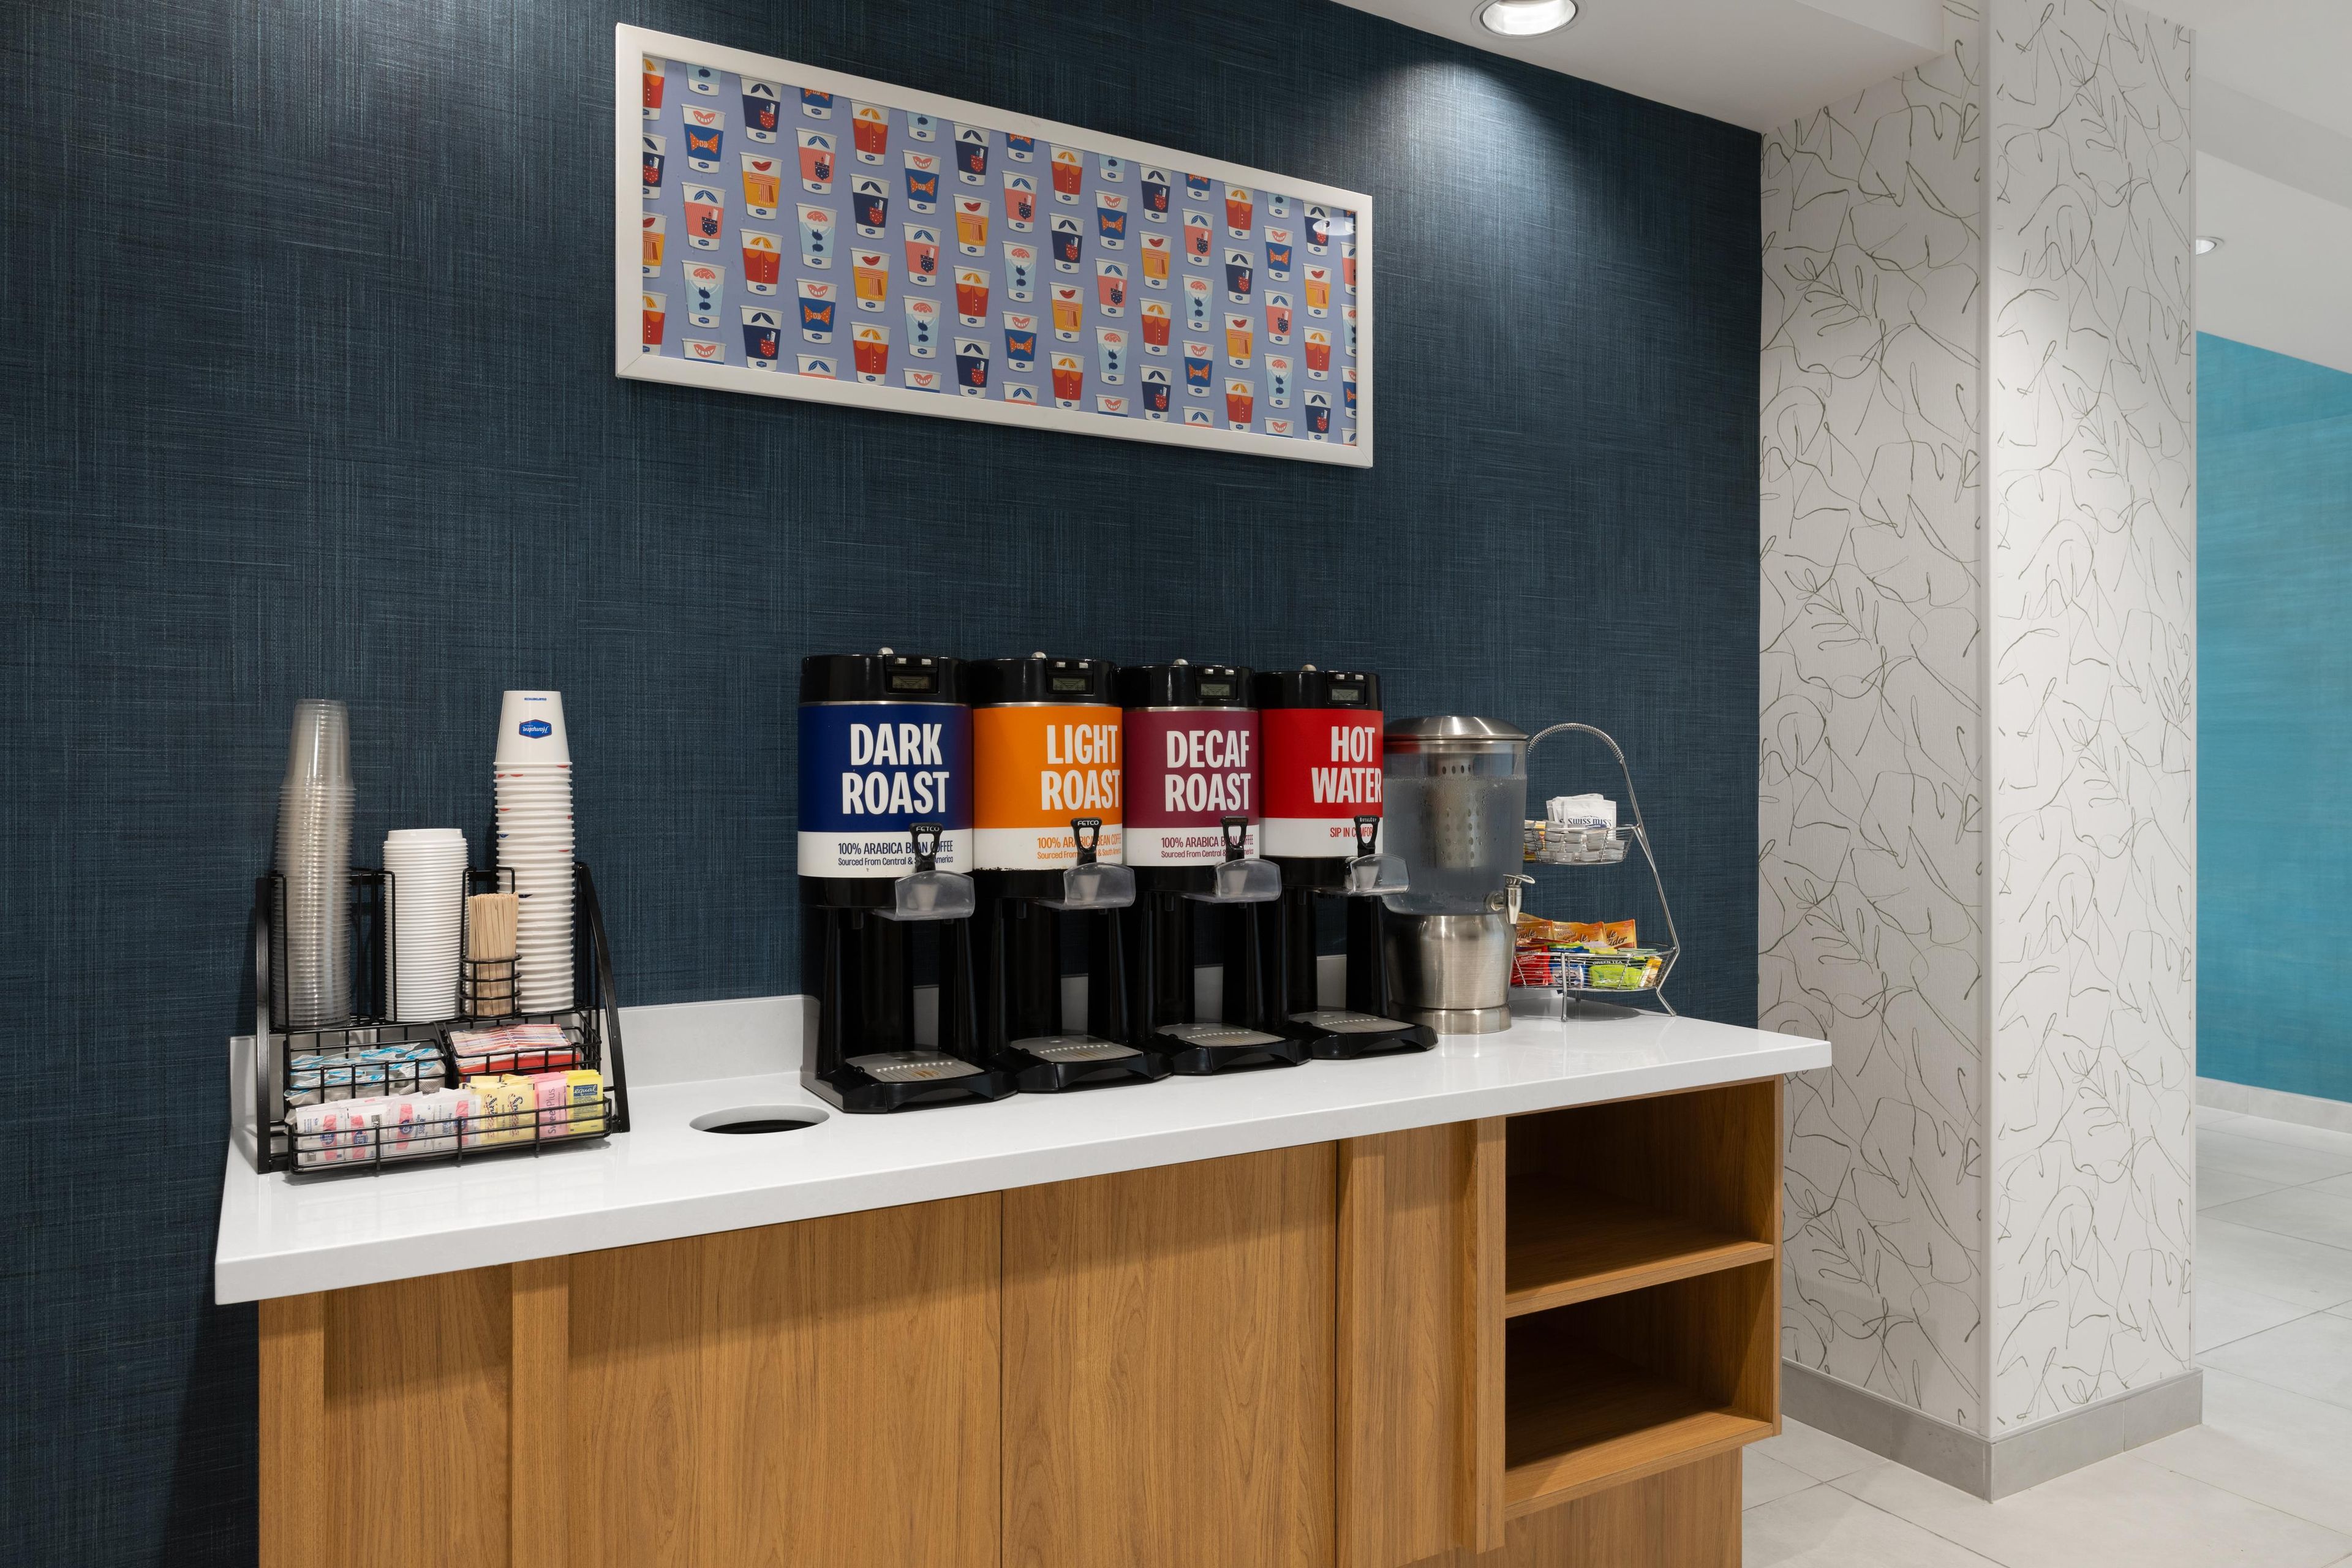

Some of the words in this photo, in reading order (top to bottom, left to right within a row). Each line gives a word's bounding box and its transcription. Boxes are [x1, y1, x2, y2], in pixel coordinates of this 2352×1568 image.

[850, 723, 943, 765] DARK
[1046, 724, 1118, 764] LIGHT
[1166, 729, 1250, 768] DECAF
[1331, 726, 1375, 763] HOT
[842, 772, 949, 815] ROAST
[1041, 770, 1120, 811] ROAST
[1165, 772, 1251, 812] ROAST
[1311, 767, 1382, 804] WATER
[838, 843, 861, 855] 100%
[864, 842, 903, 854] ARABICA
[1037, 837, 1061, 849] 100%
[1097, 834, 1110, 846] BEAN
[1161, 837, 1183, 848] 100%
[1185, 836, 1219, 848] ARABICA
[1330, 827, 1341, 837] SIP
[1343, 827, 1350, 837] IN
[838, 857, 863, 866] Sourced
[864, 857, 881, 865] From
[882, 856, 906, 865] Central
[908, 856, 913, 865] &
[1037, 851, 1063, 859] Sourced
[1063, 850, 1078, 859] From
[573, 1085, 598, 1096] equal
